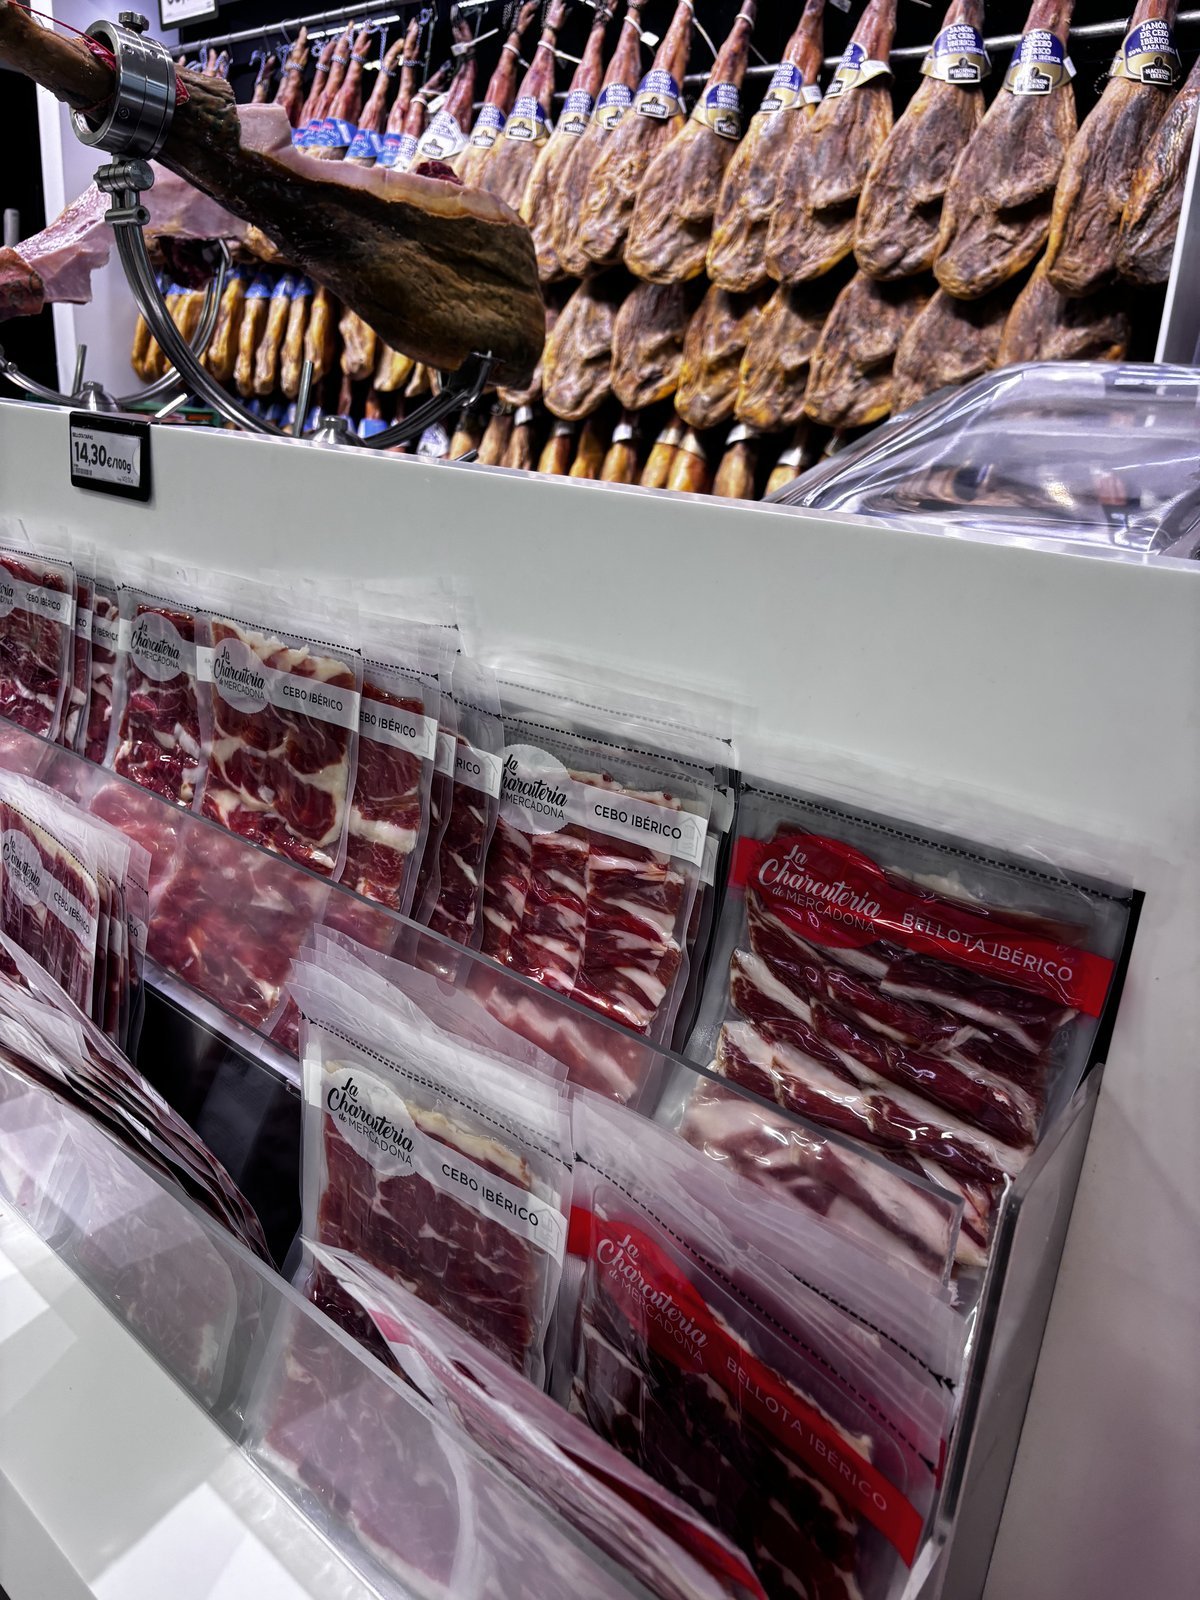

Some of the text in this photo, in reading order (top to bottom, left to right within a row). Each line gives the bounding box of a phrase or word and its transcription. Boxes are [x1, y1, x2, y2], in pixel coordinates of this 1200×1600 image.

[1141, 21, 1168, 31] JAMÓN
[1141, 36, 1169, 46] IBÉRICO
[40, 596, 61, 611] IBÉRICO
[141, 650, 180, 669] MERCADONA
[221, 646, 231, 665] La
[224, 680, 265, 700] MERCADONA
[282, 686, 343, 712] CEBO IBÉRICO
[360, 711, 416, 738] EBO IBÉRICO
[456, 757, 481, 775] RICO
[504, 754, 519, 776] La
[506, 792, 565, 820] MERCADONA
[594, 804, 682, 840] CEBO IBÉRICO
[783, 844, 808, 872] La
[54, 892, 69, 912] CEBO
[772, 885, 876, 934] de MERCADONA
[902, 913, 1073, 982] BELLOTA IBÉRICO
[341, 1077, 359, 1103] La
[338, 1112, 413, 1168] de MERCADONA
[442, 1164, 539, 1226] CEBO IBÉRICO
[616, 1234, 639, 1266] La
[621, 1278, 703, 1364] MERCADONA
[726, 1356, 888, 1511] BELLOTA IBÉRICO
